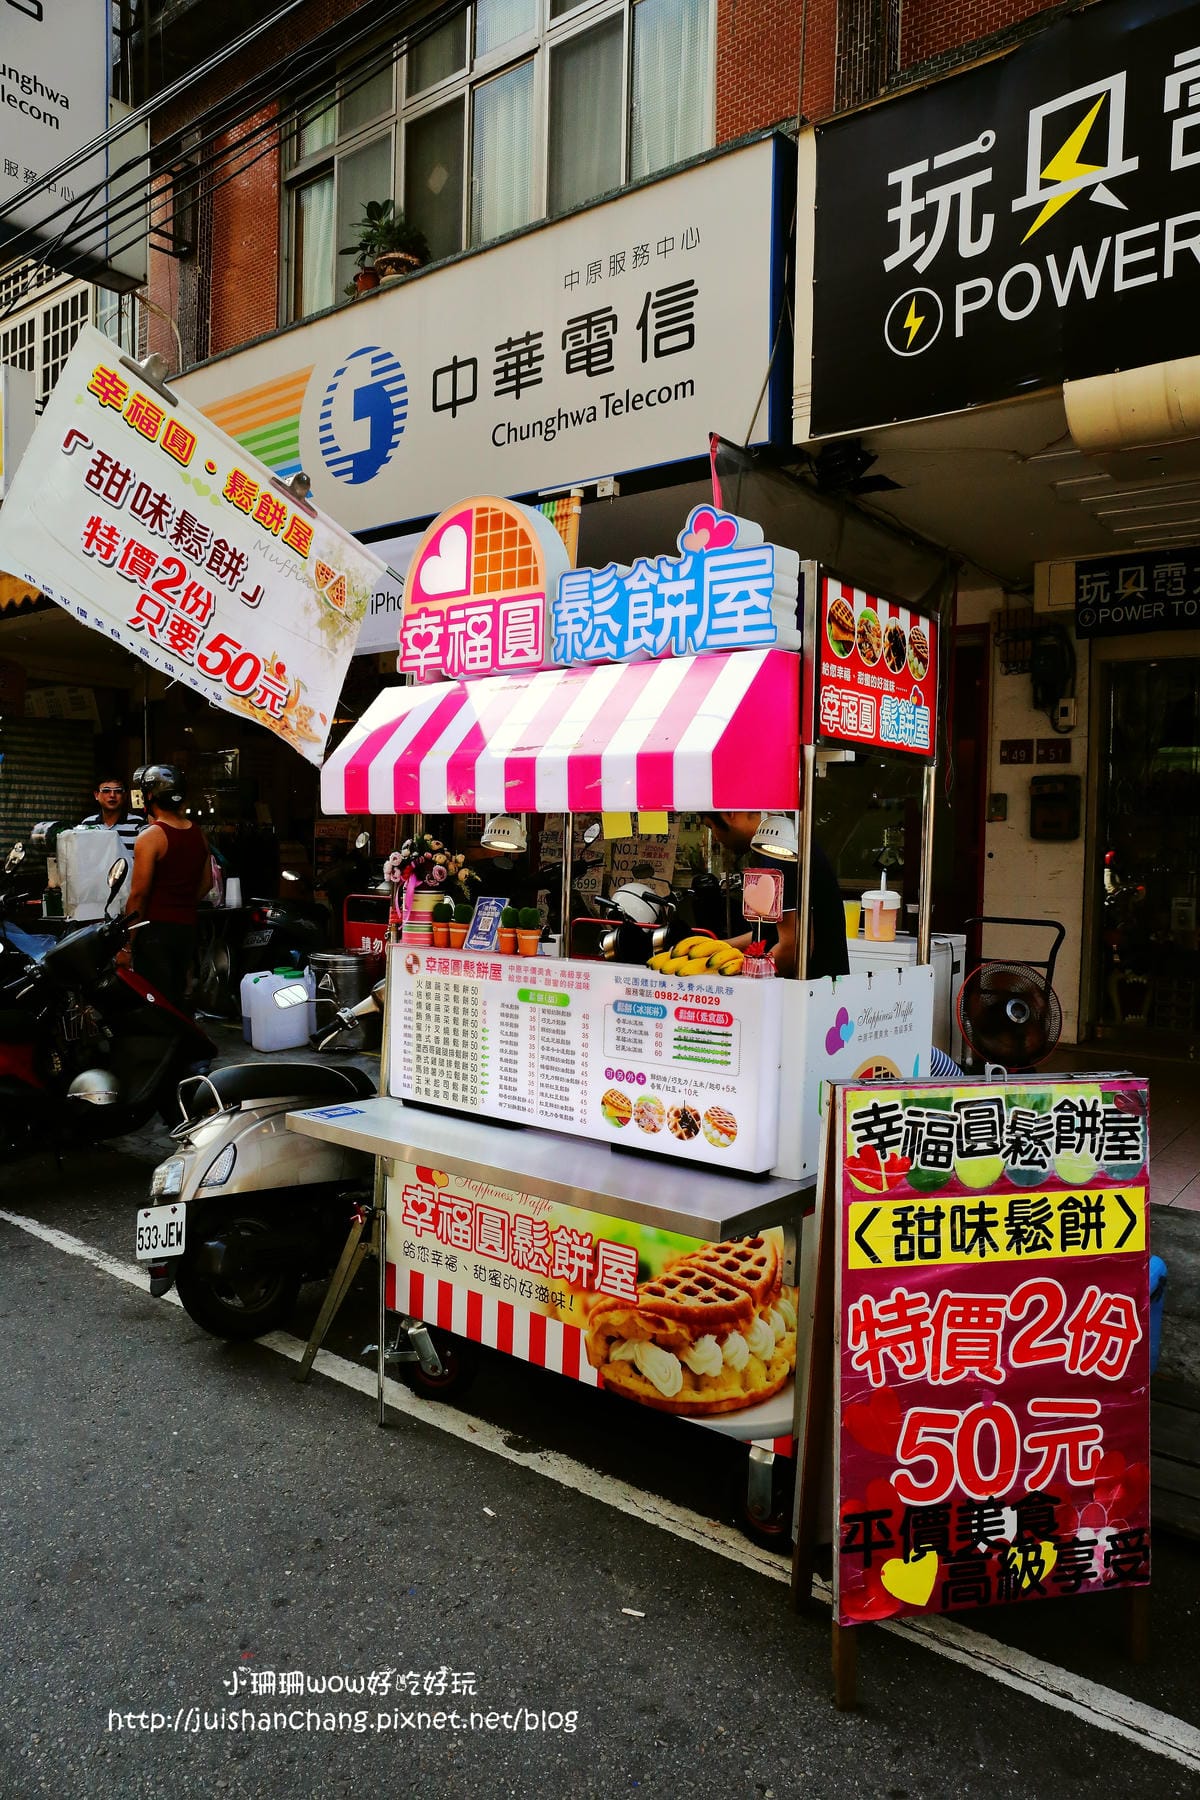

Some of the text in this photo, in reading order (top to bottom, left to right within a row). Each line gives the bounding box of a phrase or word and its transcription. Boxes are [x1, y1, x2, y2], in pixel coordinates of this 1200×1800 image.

[564, 226, 700, 291] 中原服務中心
[955, 211, 1200, 338] POWER
[432, 278, 699, 419] 中華電信
[491, 379, 695, 447] Chunghwa Telecom
[82, 515, 216, 627] 特價2份
[553, 546, 777, 664] 鬆餅屋
[1079, 562, 1200, 605] 玩具電
[400, 597, 544, 681] 幸福圓
[1098, 602, 1165, 625] POWER
[127, 593, 290, 717] 只要50元
[820, 685, 931, 749] 幸福圓 鬆餅屋
[425, 956, 503, 982] 幸福圓鬆餅屋
[654, 990, 721, 1006] 0982-478029
[850, 1097, 1145, 1171] 幸福圓鬆餅屋
[401, 1183, 640, 1304] 幸福圓鬆餅屋
[848, 1276, 1143, 1388] 特價2份
[891, 1396, 1105, 1506] 50元
[841, 1495, 1061, 1568] 平價美食
[940, 1529, 1150, 1606] 高級享受
